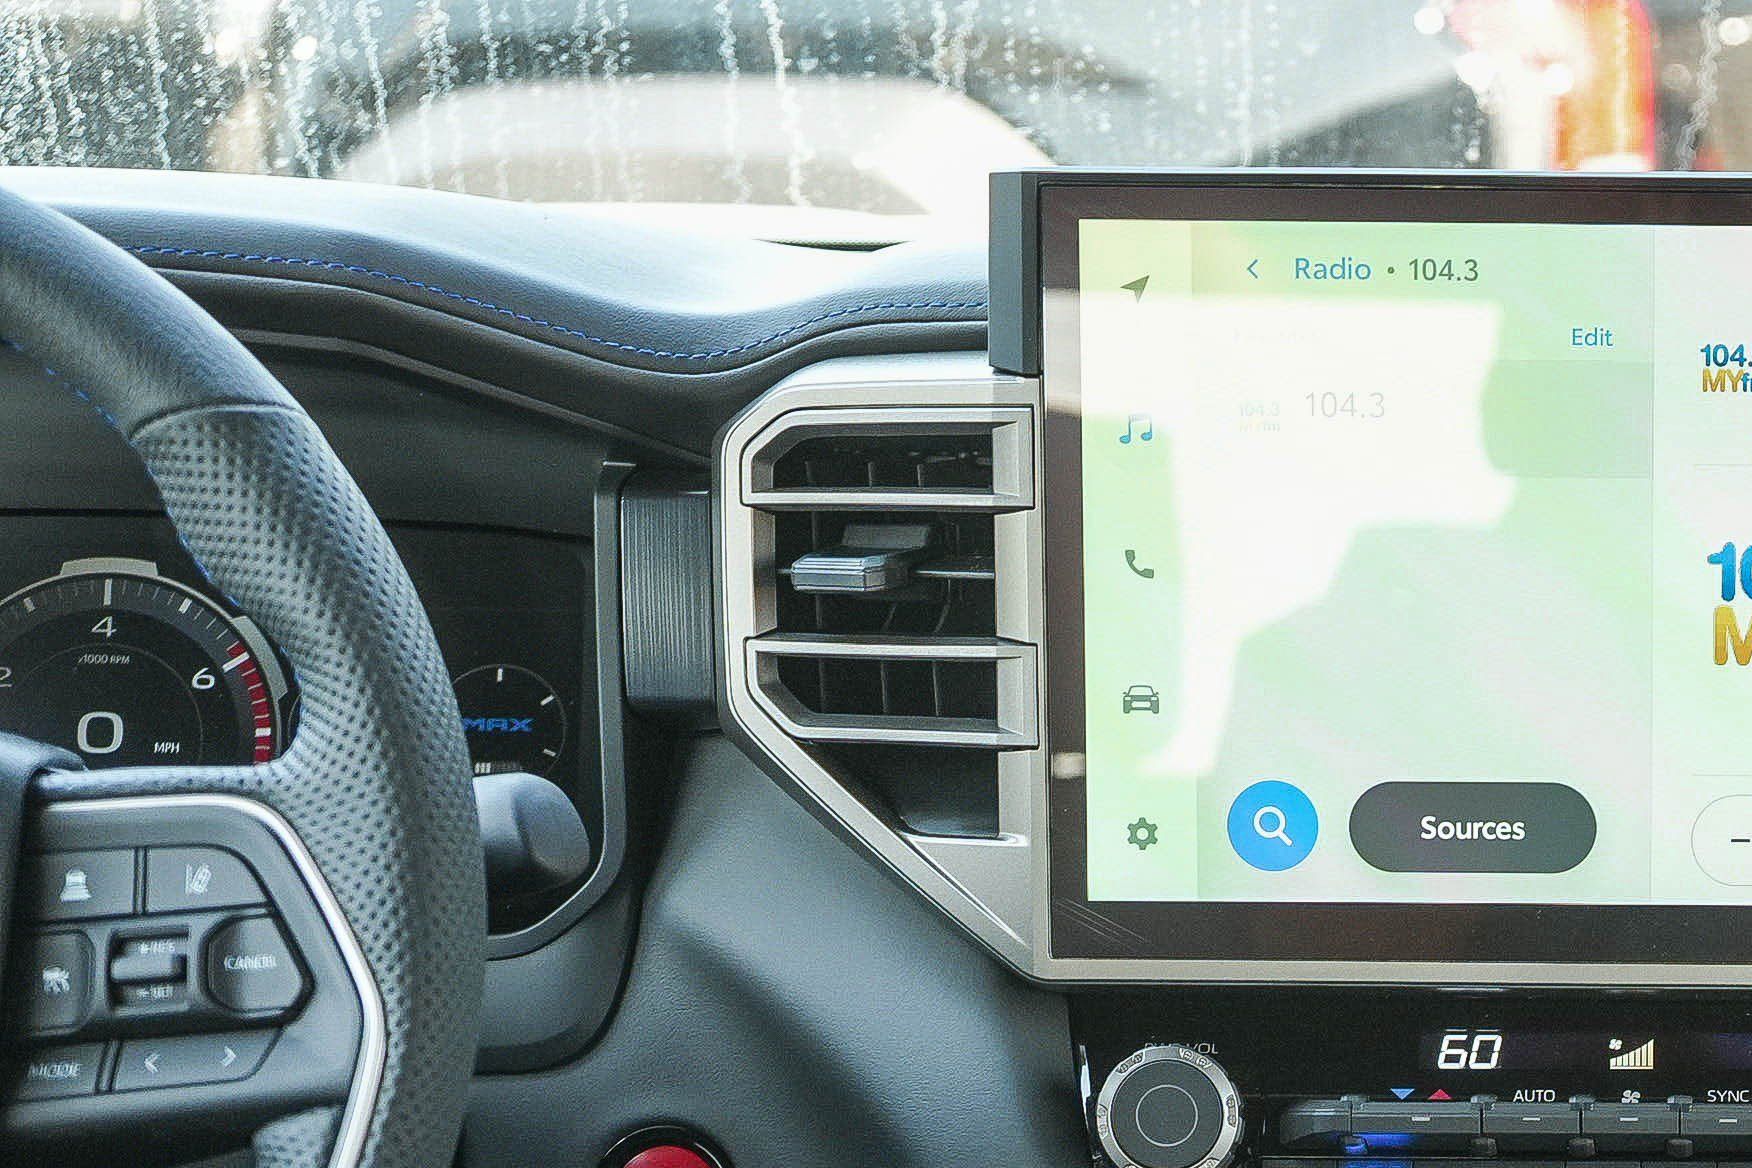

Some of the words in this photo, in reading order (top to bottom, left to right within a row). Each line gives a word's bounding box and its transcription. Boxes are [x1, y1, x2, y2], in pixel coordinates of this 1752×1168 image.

[1294, 257, 1372, 281] Radio
[1409, 258, 1480, 283] 104.3
[1571, 327, 1614, 349] Edit
[1304, 392, 1386, 420] 104.3
[91, 615, 117, 638] 4
[191, 667, 215, 690] 6
[77, 711, 124, 754] 0
[463, 717, 535, 732] MAX
[154, 742, 180, 754] MPH
[1420, 815, 1526, 841] Sources
[1437, 1035, 1502, 1071] 60
[1513, 1088, 1556, 1103] AUTO
[1707, 1089, 1749, 1104] SYNC
